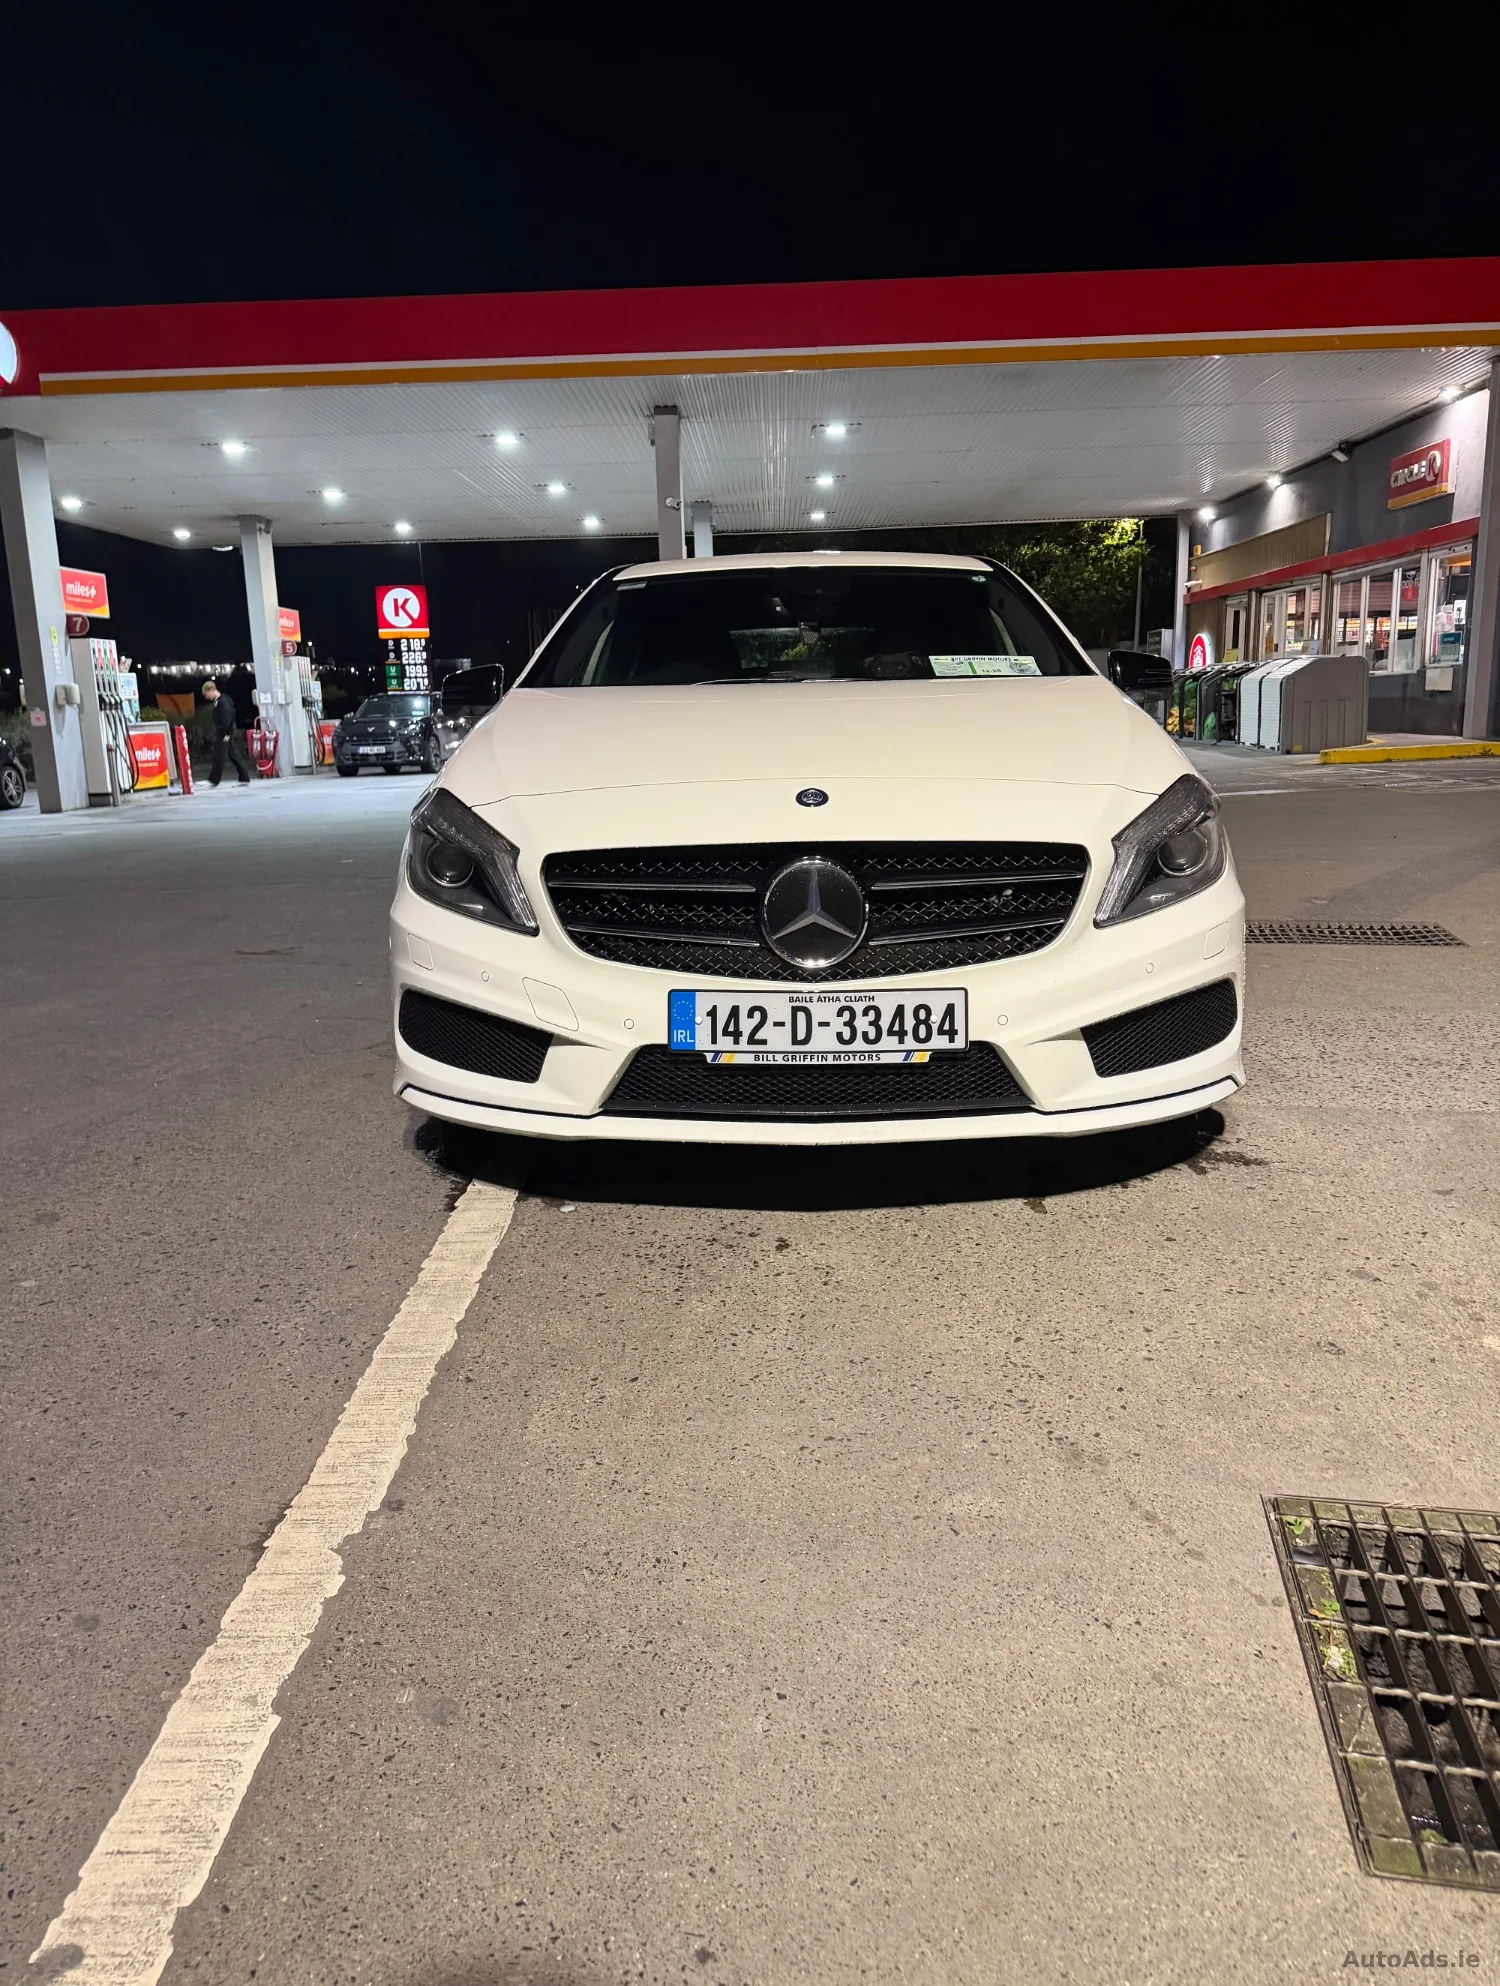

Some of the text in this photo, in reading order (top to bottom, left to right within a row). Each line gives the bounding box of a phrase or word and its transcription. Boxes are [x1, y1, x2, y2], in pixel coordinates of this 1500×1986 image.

[72, 617, 82, 632] 7
[286, 642, 293, 653] 5
[788, 993, 875, 1003] BAILE ÁTHA CLIATH
[706, 1002, 958, 1046] 142-D-33484
[673, 1029, 694, 1043] IRL
[753, 1053, 881, 1062] BILL GRIFFIN MOTORS
